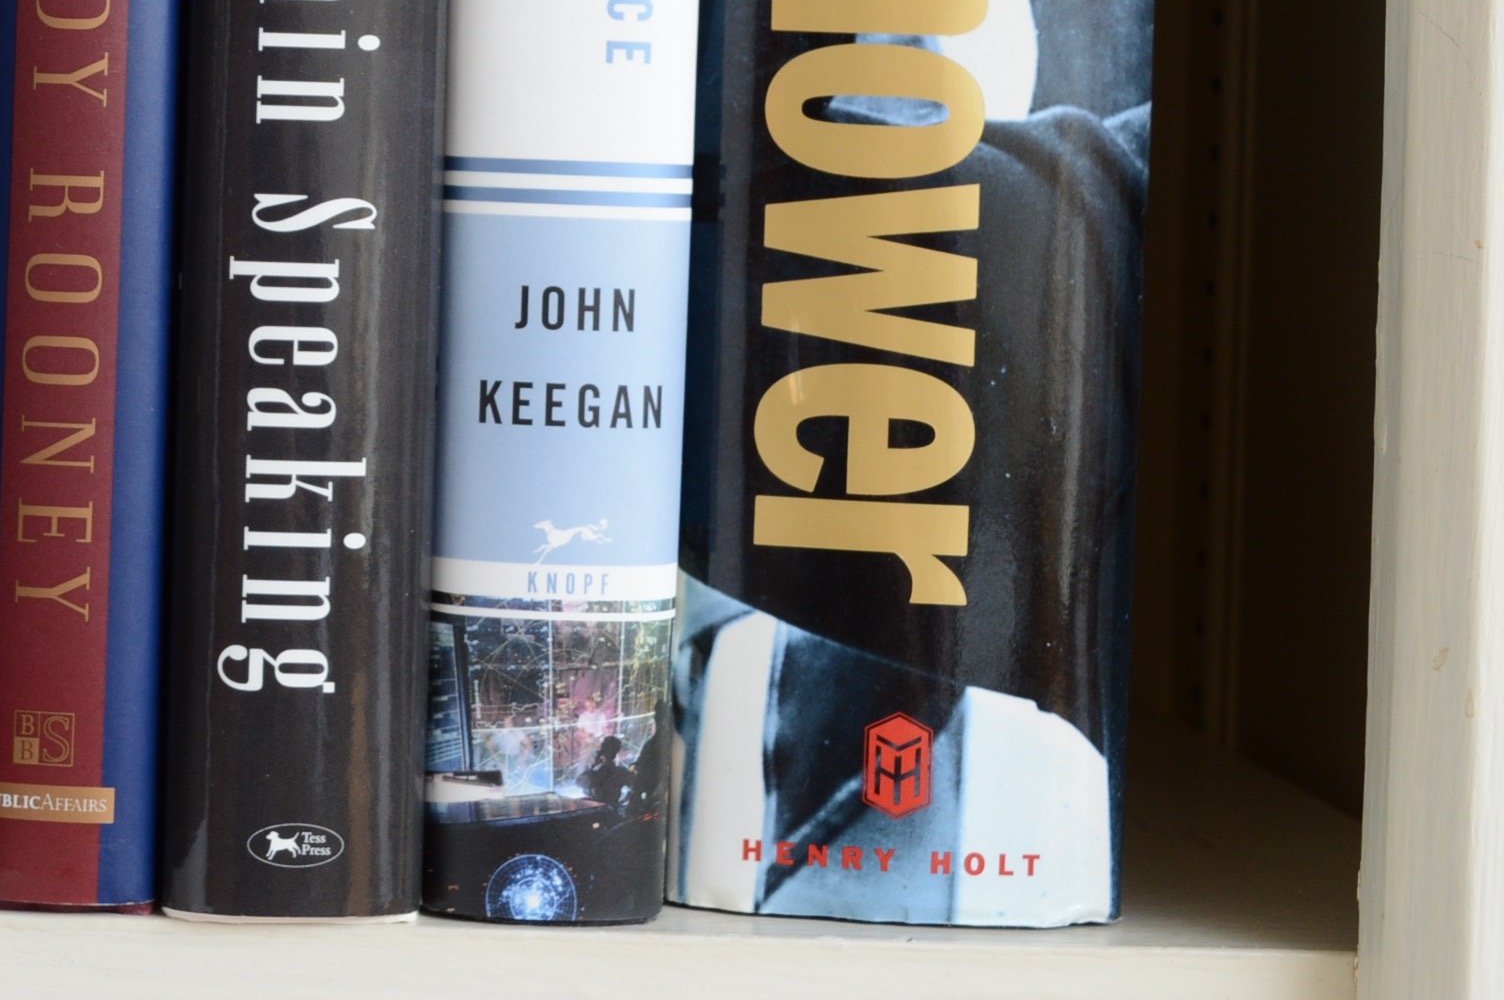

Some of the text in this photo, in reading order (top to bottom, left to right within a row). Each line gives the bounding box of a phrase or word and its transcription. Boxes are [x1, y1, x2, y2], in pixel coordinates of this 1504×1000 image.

[514, 284, 636, 332] JOHN
[14, 167, 105, 622] ROONEY
[478, 379, 663, 429] KEEGAN
[217, 193, 378, 693] Speaking
[526, 570, 610, 596] KNOPF
[301, 831, 326, 844] Tess
[301, 844, 331, 856] Press
[742, 838, 1043, 877] HENRY HOLT
